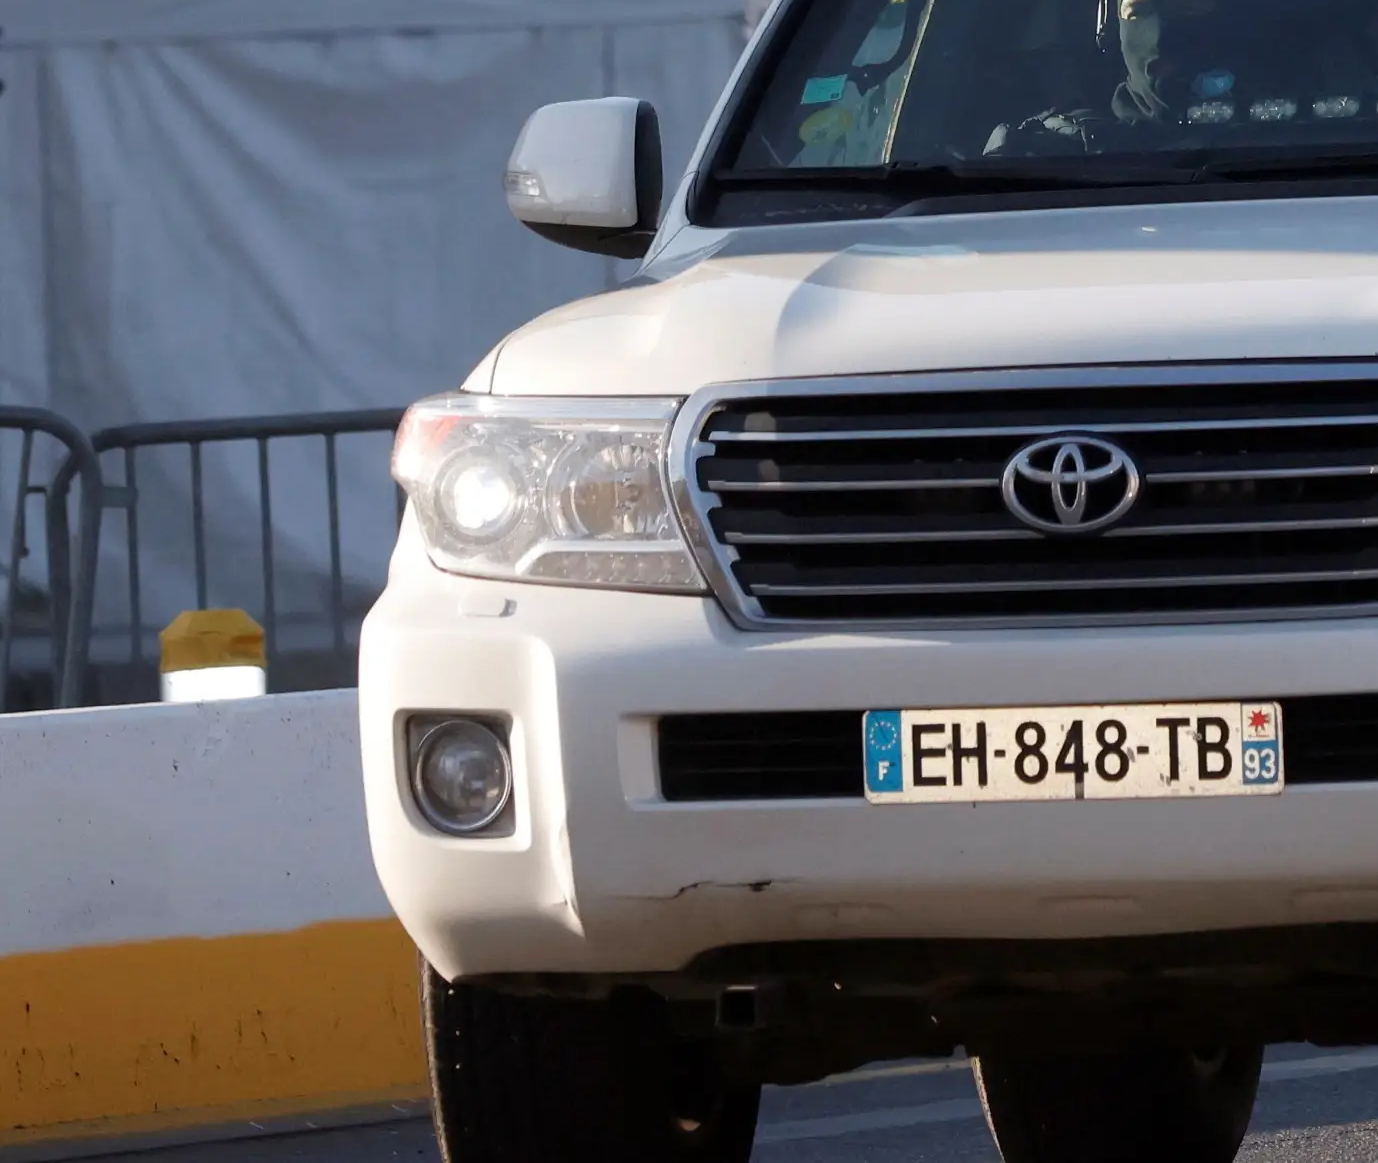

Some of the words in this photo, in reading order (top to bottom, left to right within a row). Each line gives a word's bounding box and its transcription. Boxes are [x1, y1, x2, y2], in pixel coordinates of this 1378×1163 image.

[911, 716, 1233, 788] EH-848-TB
[1243, 747, 1276, 780] 93
[878, 760, 890, 781] F
